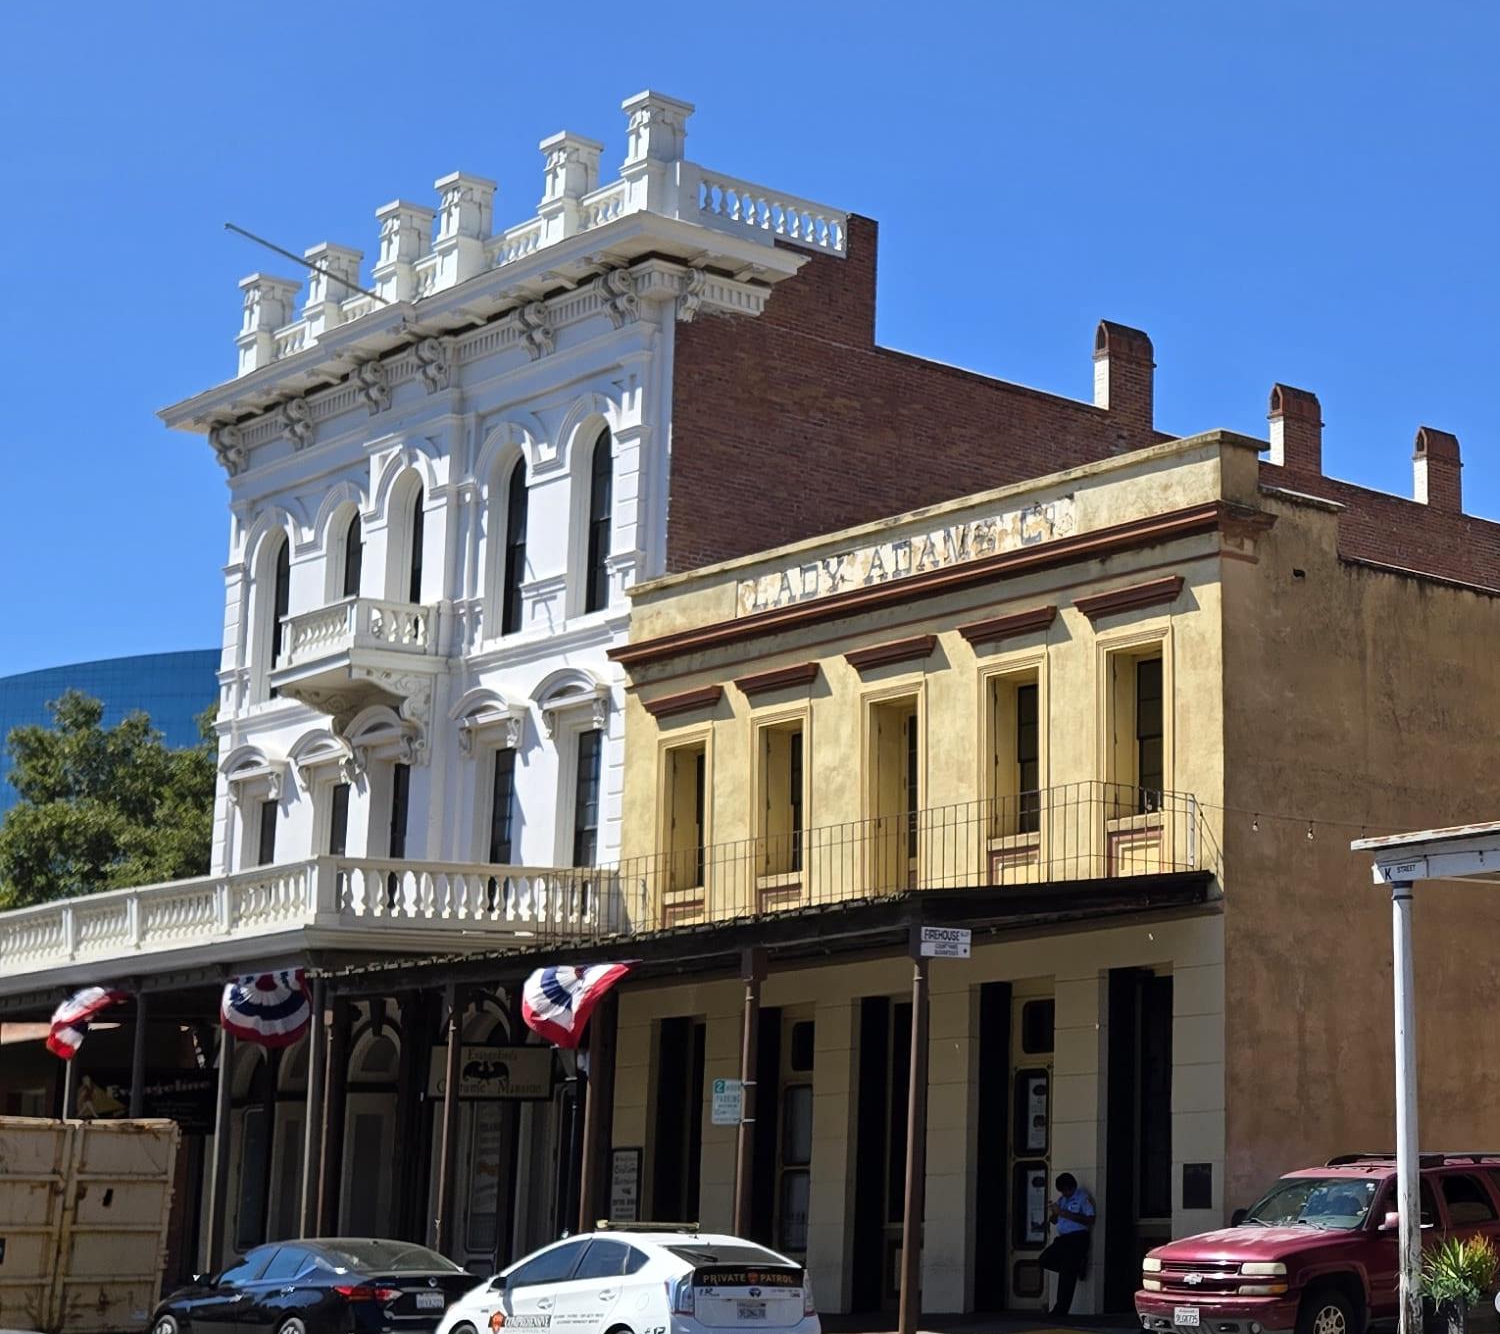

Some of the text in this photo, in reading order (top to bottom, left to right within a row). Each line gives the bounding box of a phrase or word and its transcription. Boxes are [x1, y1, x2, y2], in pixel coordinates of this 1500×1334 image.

[752, 556, 846, 612] LADY
[1384, 864, 1416, 880] K STREET
[924, 928, 961, 942] FIREHOUSE
[703, 1273, 794, 1284] PRIVATE PATROL
